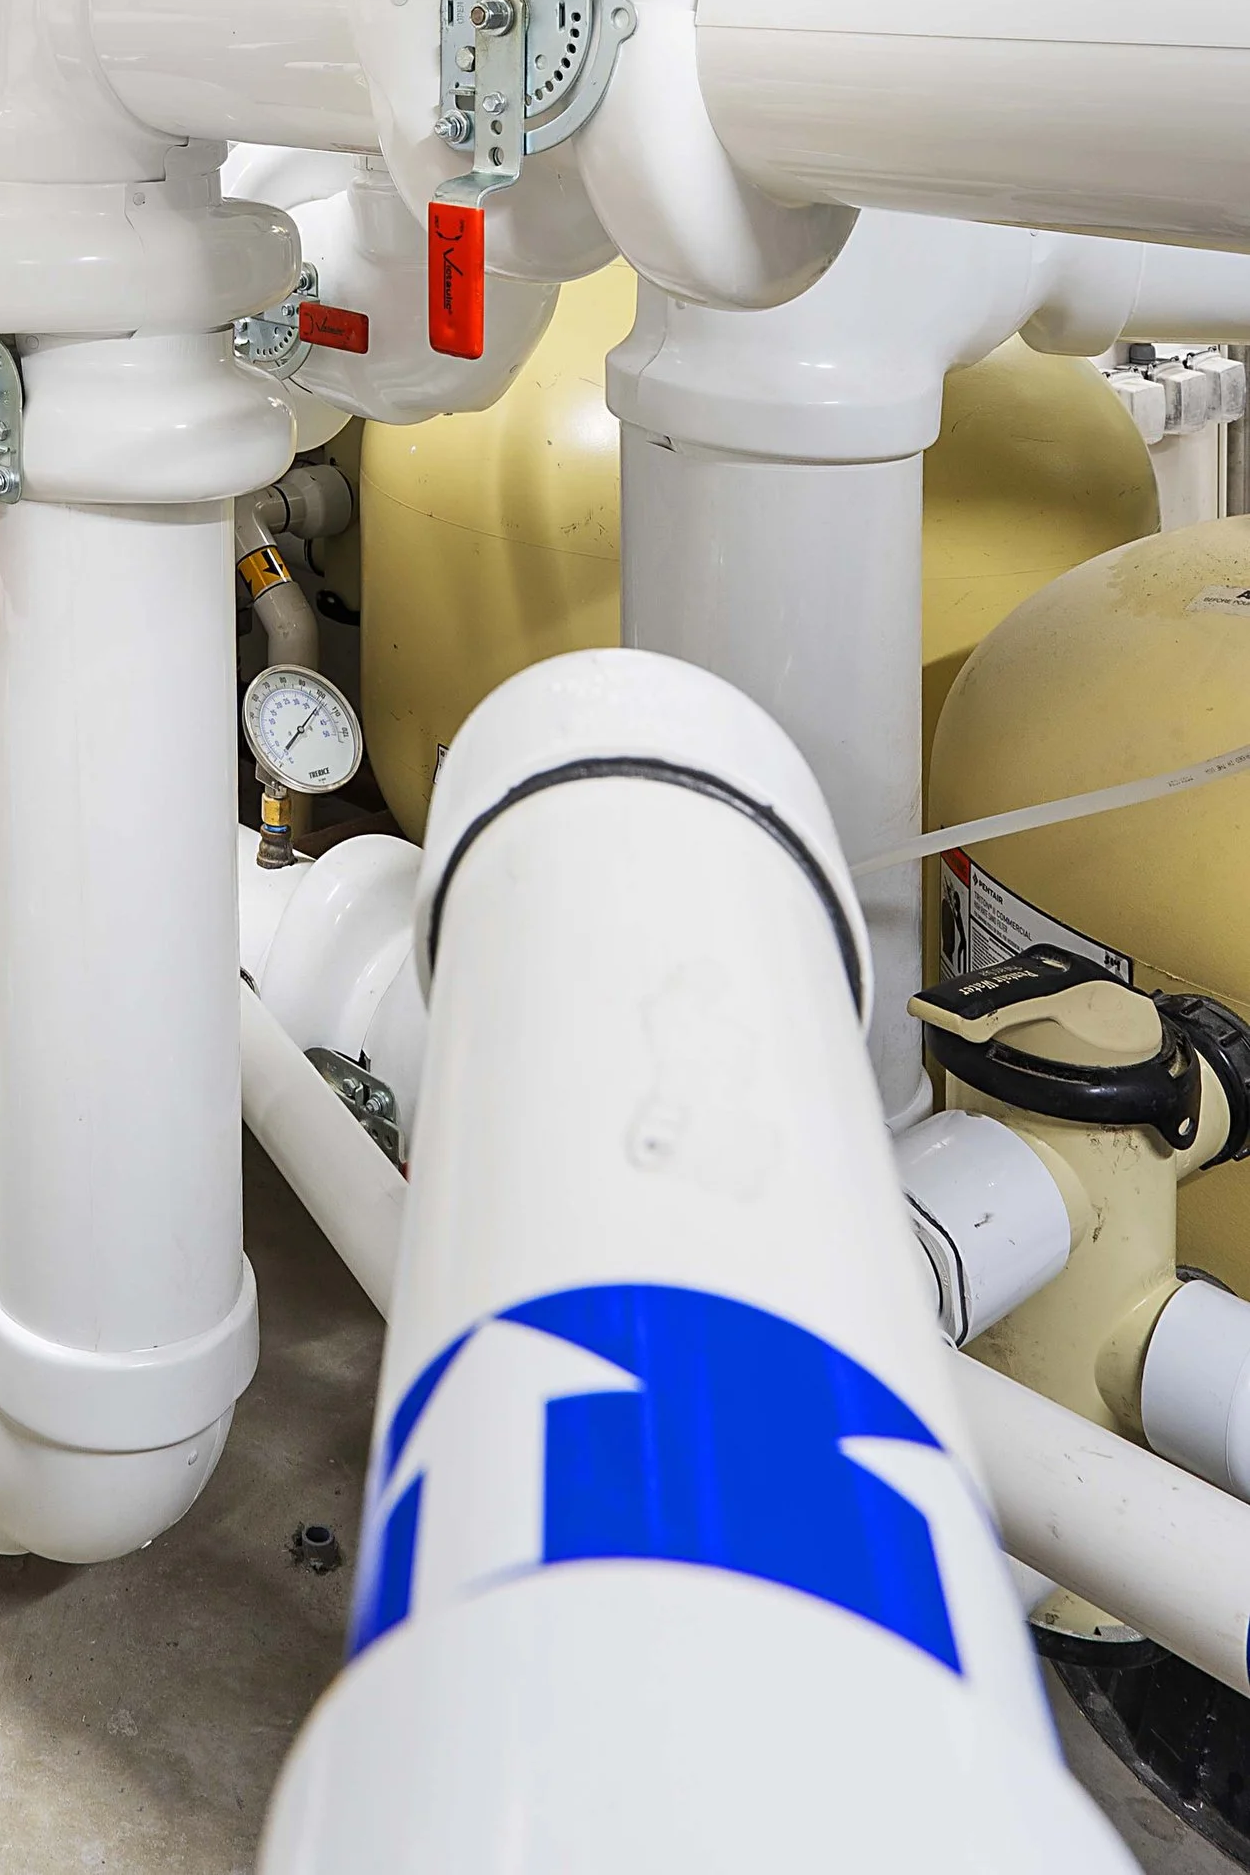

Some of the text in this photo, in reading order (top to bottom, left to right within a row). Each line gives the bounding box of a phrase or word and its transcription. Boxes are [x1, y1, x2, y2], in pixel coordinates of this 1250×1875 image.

[456, 0, 465, 24] OPEN
[443, 247, 463, 311] Victaulic
[331, 706, 342, 718] 110
[309, 767, 330, 779] TRERICE
[978, 879, 1004, 905] PENTAIR
[996, 910, 1033, 942] COMMERCIAL
[958, 978, 1000, 996] Water
